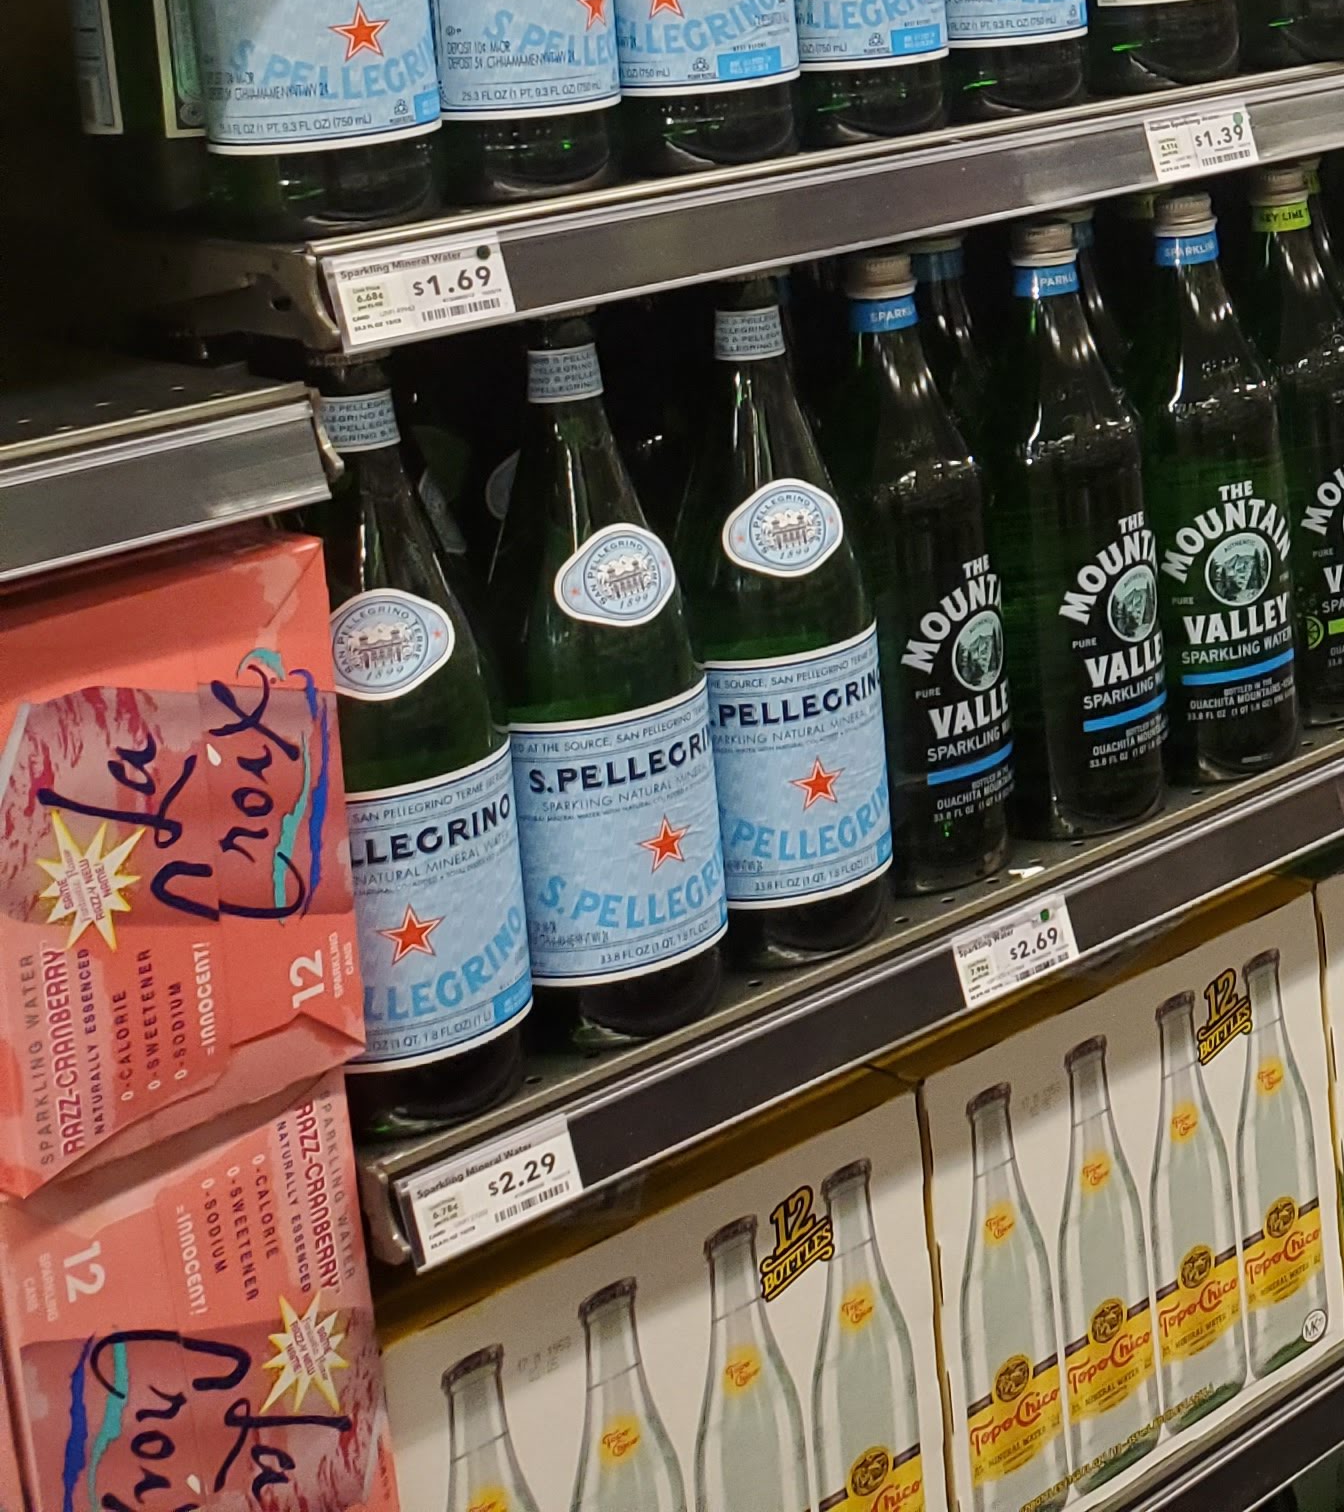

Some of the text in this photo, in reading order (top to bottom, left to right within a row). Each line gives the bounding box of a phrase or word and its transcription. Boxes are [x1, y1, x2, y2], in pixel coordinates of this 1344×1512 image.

[1195, 125, 1243, 147] $1.39
[340, 252, 461, 279] Sparkling Mineral Water
[413, 266, 491, 296] $1.69
[1218, 480, 1253, 501] THE
[1117, 511, 1145, 534] THE
[1160, 499, 1291, 584] MOUNTAIN
[779, 547, 810, 559] 1899
[962, 553, 991, 579] THE
[619, 595, 649, 610] 1899
[1183, 592, 1290, 645] VALLEY
[367, 665, 404, 680] 1899
[771, 660, 849, 686] SAN PELLEGRINO
[993, 930, 1014, 942] Water
[1010, 928, 1057, 960] $2.69
[289, 948, 326, 1009] 12
[1203, 969, 1237, 1024] 12
[19, 954, 55, 1166] SPARKLING WATER
[42, 947, 85, 1158] RAZZ-CRANBERRY
[77, 948, 106, 1135] NATURALLY ESSENCED
[1200, 1006, 1252, 1062] BOTTLES
[295, 1100, 339, 1289] RAZZ-CRANBERRY
[416, 1144, 532, 1199] Sparkling Mineral Water
[488, 1152, 555, 1196] $2.29
[276, 1119, 312, 1295] NATURALLY ESSENCED
[771, 1186, 813, 1254] 12
[63, 1240, 106, 1302] 12
[763, 1224, 833, 1296] BOTTLES
[1245, 1227, 1321, 1284] Topo Chico
[1159, 1277, 1238, 1337] Topo Chico
[1067, 1331, 1152, 1393] Topo Chico
[969, 1387, 1060, 1455] Topo Chico
